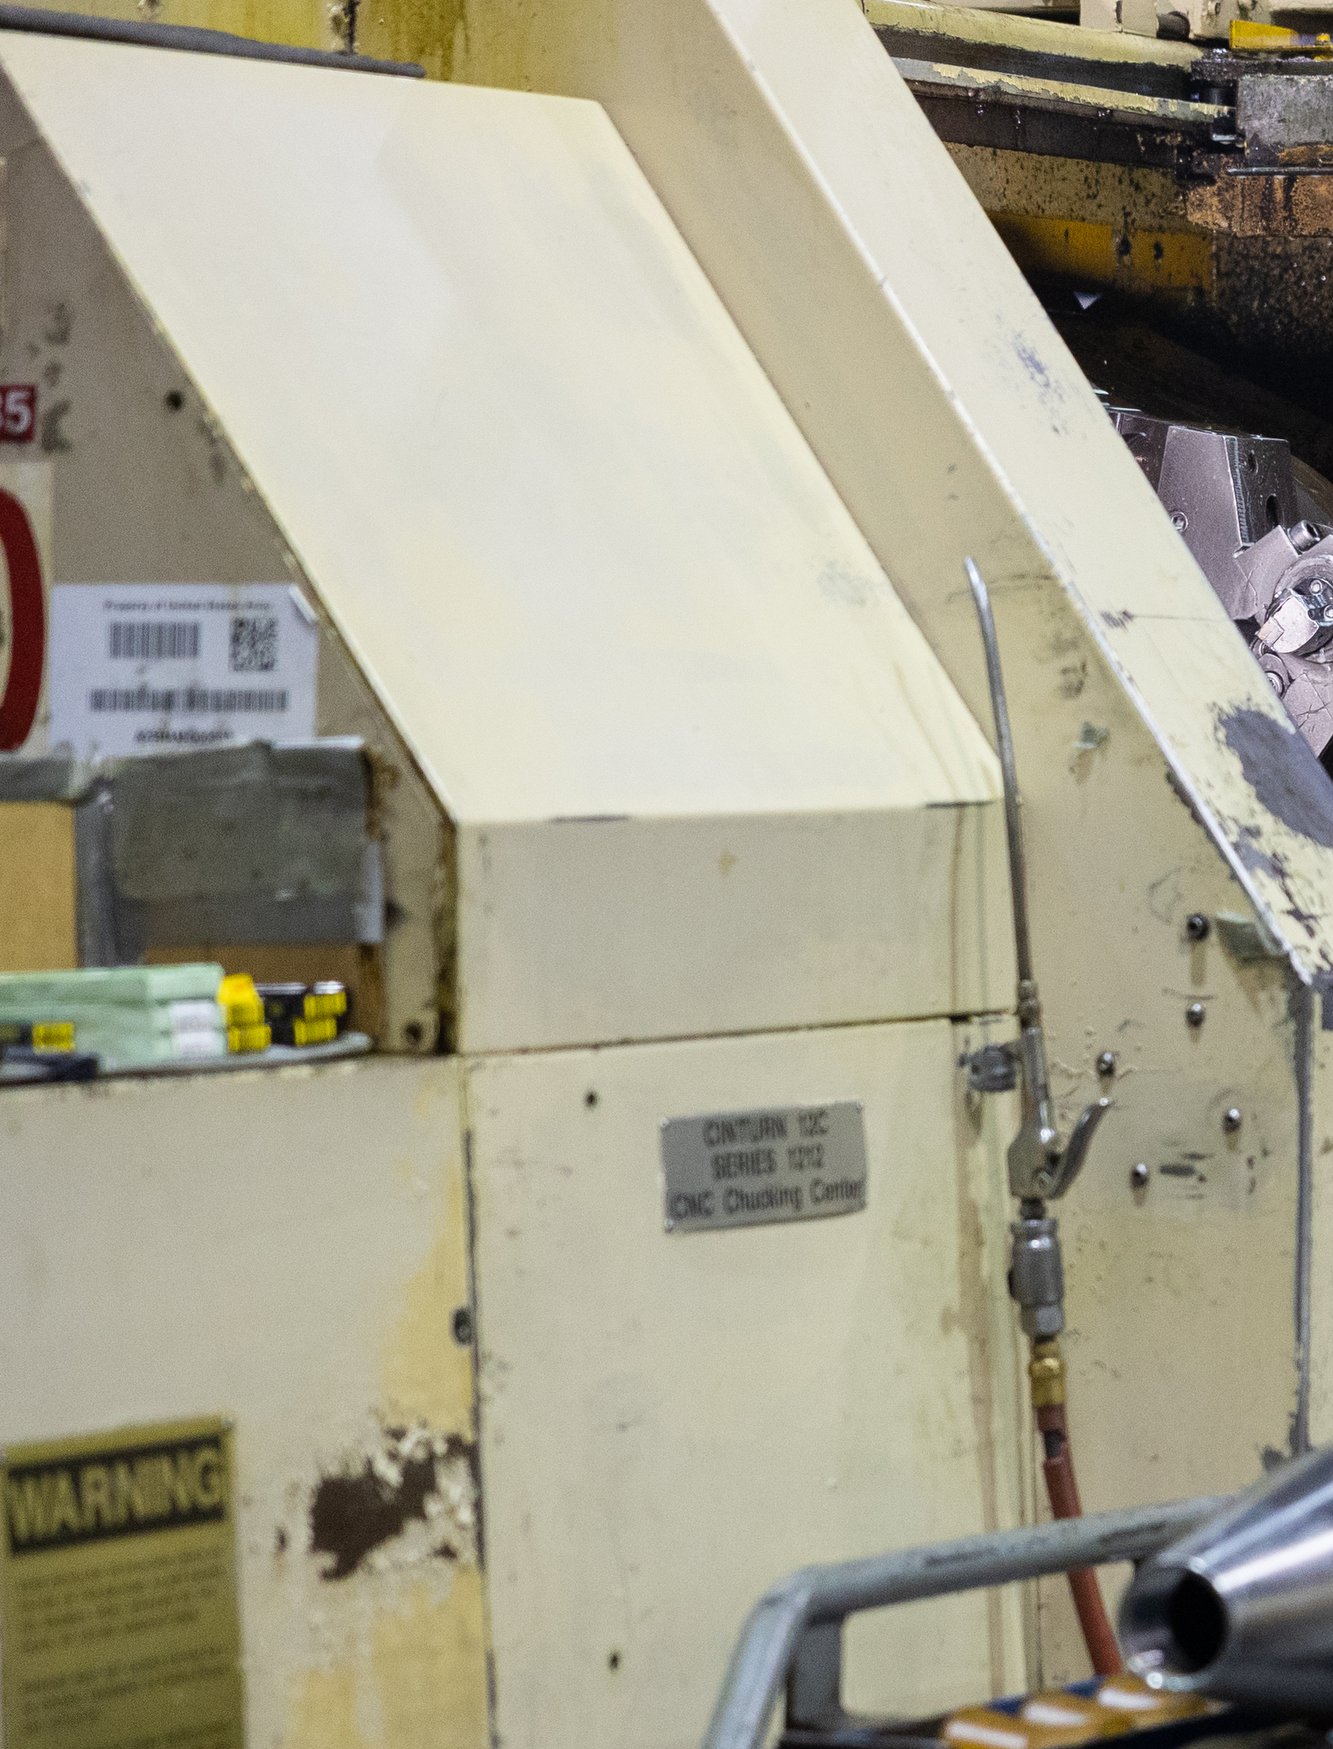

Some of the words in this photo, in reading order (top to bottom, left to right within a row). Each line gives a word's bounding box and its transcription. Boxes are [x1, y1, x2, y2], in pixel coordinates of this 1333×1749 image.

[711, 1148, 777, 1181] SERIES
[668, 1189, 716, 1220] CNC
[722, 1185, 803, 1214] Chucking
[809, 1177, 865, 1204] Center
[10, 1447, 222, 1542] WARNING
